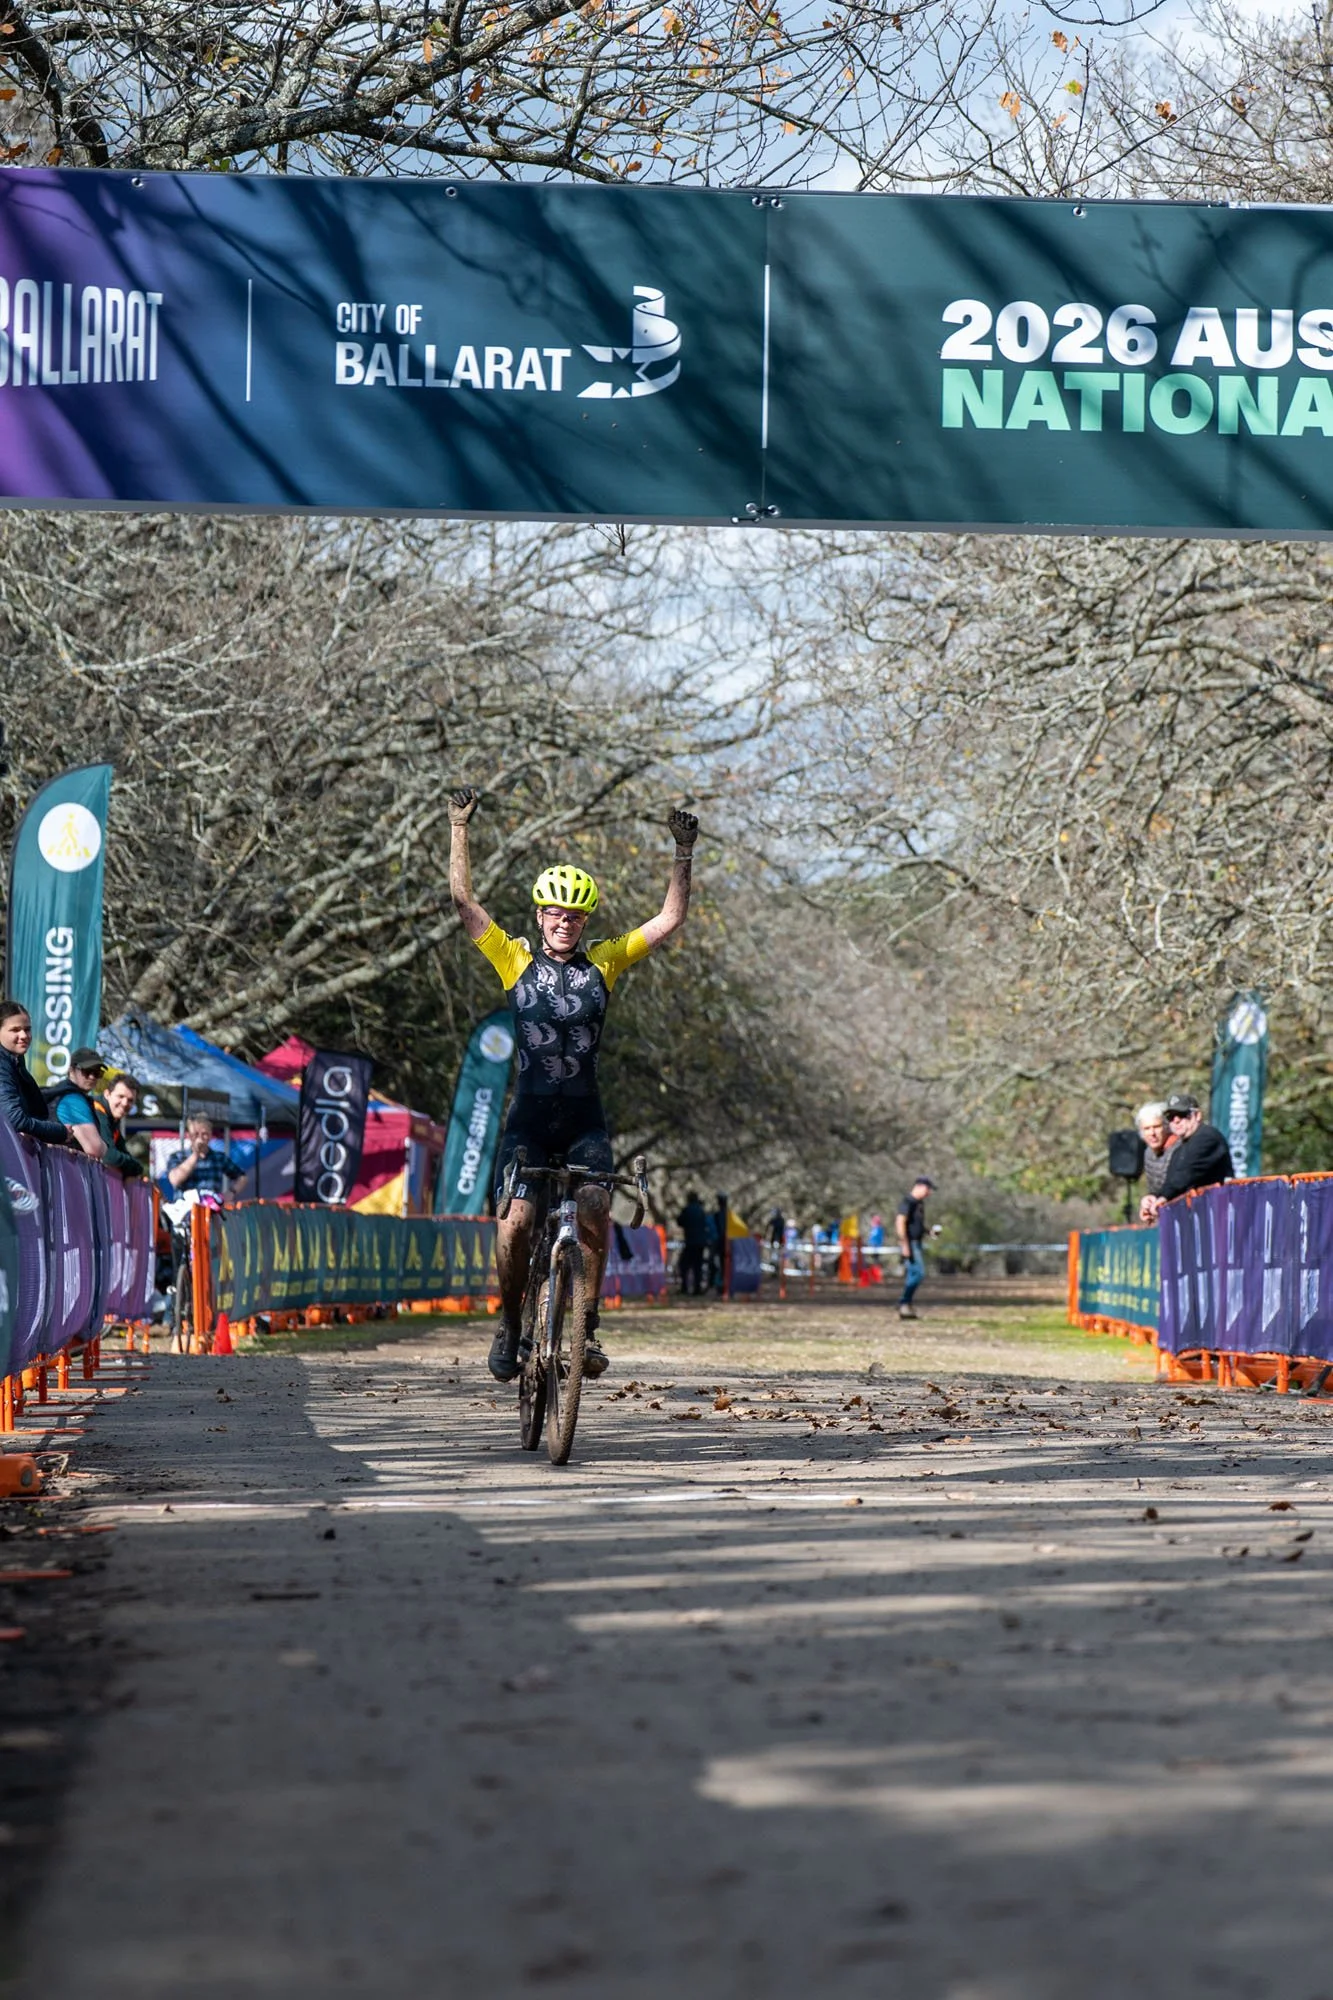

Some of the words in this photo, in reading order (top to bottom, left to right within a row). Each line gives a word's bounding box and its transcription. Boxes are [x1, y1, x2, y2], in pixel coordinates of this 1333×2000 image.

[336, 302, 386, 334] CITY
[395, 304, 422, 335] OF
[941, 299, 1157, 366] 2026
[1170, 306, 1333, 371] AUS
[335, 341, 571, 391] BALLARAT
[942, 369, 1333, 436] NATIONA
[314, 1066, 352, 1203] pedla
[457, 1087, 492, 1194] CROSSING
